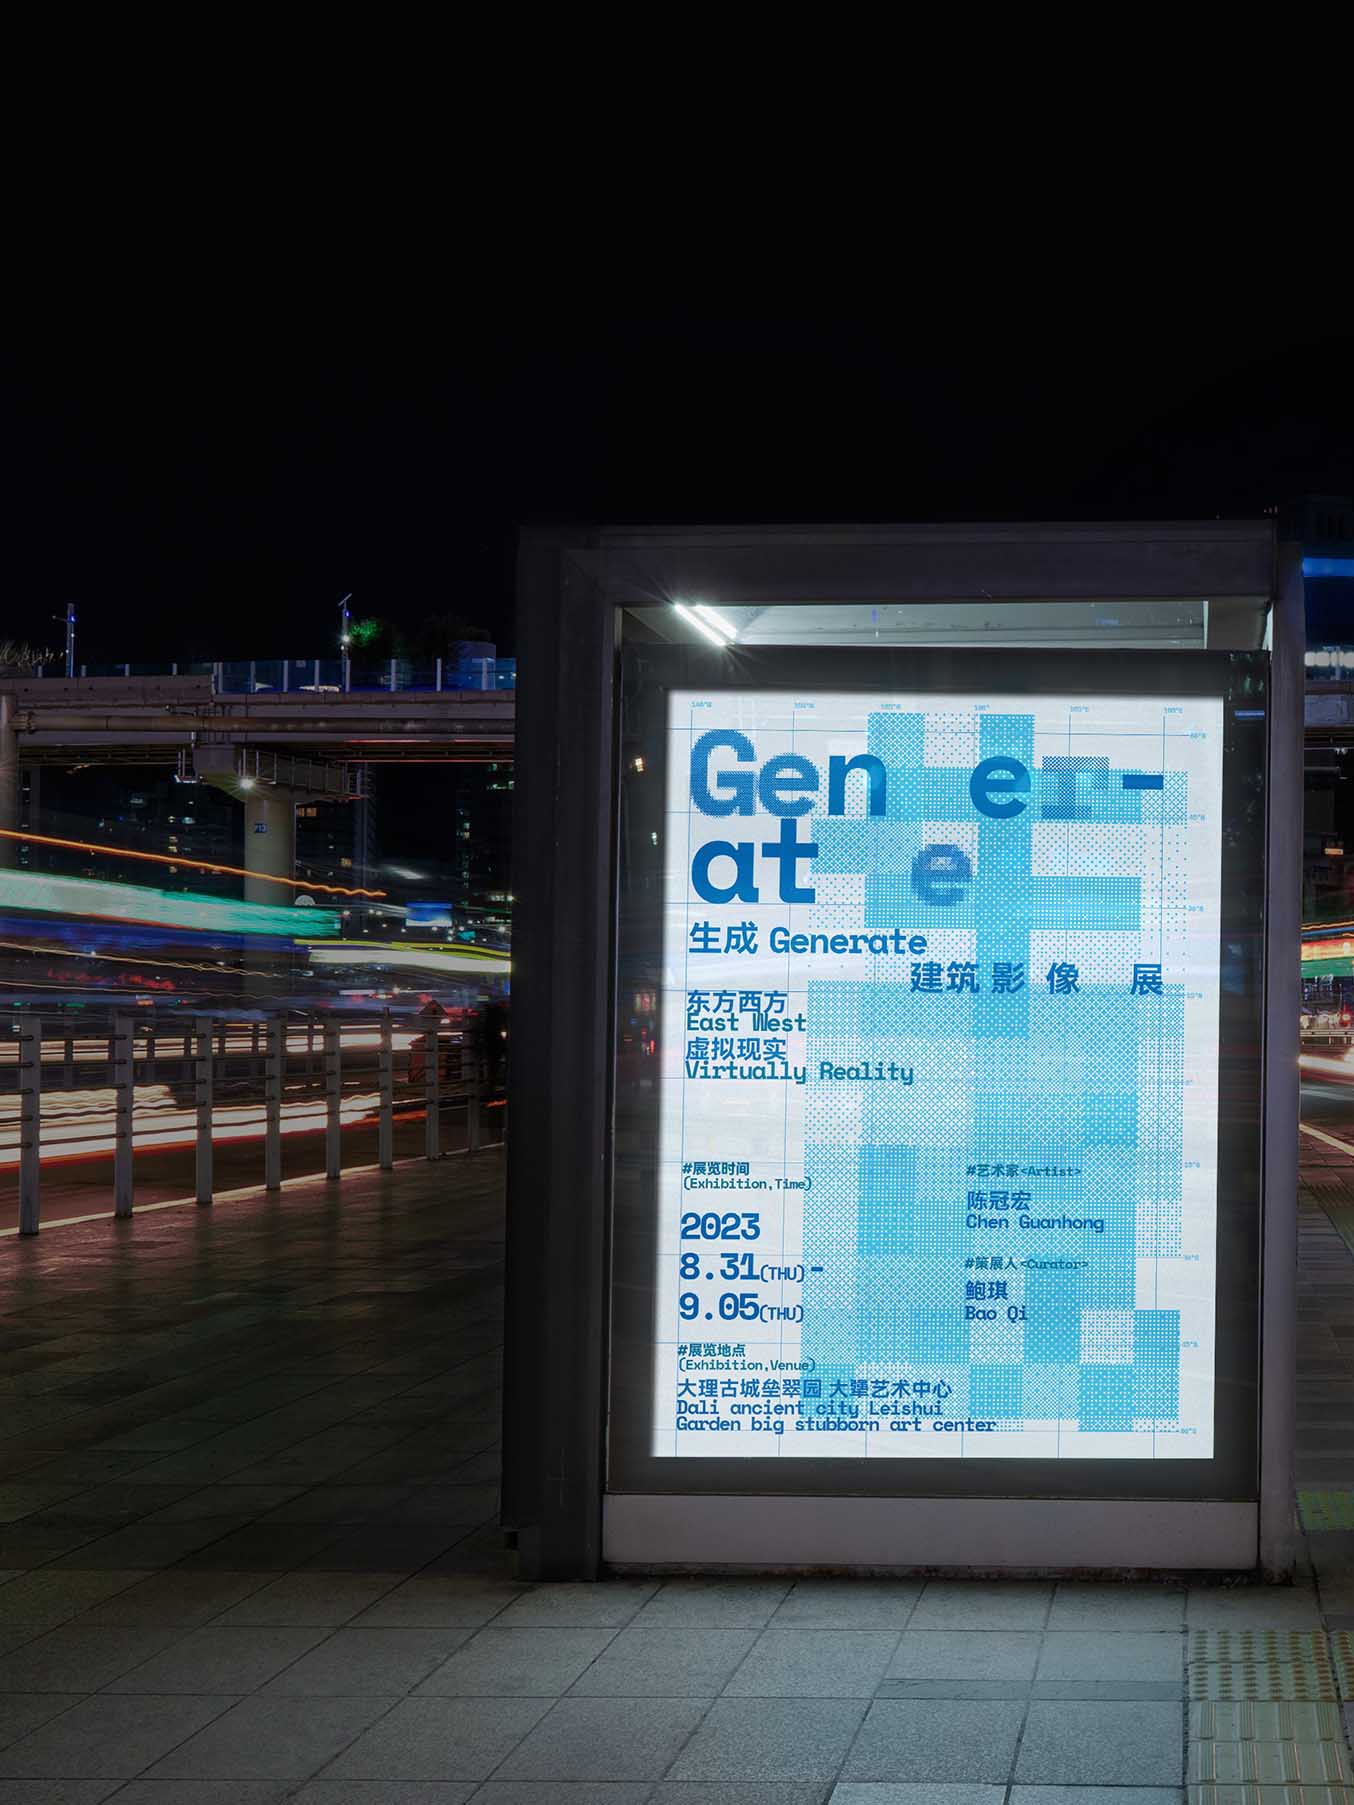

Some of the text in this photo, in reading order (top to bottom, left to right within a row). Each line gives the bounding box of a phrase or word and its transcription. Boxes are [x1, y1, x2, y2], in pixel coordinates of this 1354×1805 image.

[691, 729, 886, 817] Gen
[691, 818, 818, 904] at
[689, 921, 927, 955] 生成 Generate
[910, 961, 980, 994] 建筑
[687, 990, 788, 1014] 东方西方
[687, 1013, 806, 1031] East West
[686, 1037, 787, 1061] 虚拟现实
[686, 1061, 914, 1085] Virtually Reality
[967, 1190, 1032, 1211] 陈冠宏
[680, 1212, 761, 1240] 2023
[966, 1213, 1105, 1233] Chen Guanhong
[965, 1280, 1008, 1301] 鲍琪
[965, 1306, 1029, 1323] Bao Qi
[676, 1400, 943, 1419] Dali ancient city Leishui
[676, 1416, 997, 1435] Garden big stubborn art center
